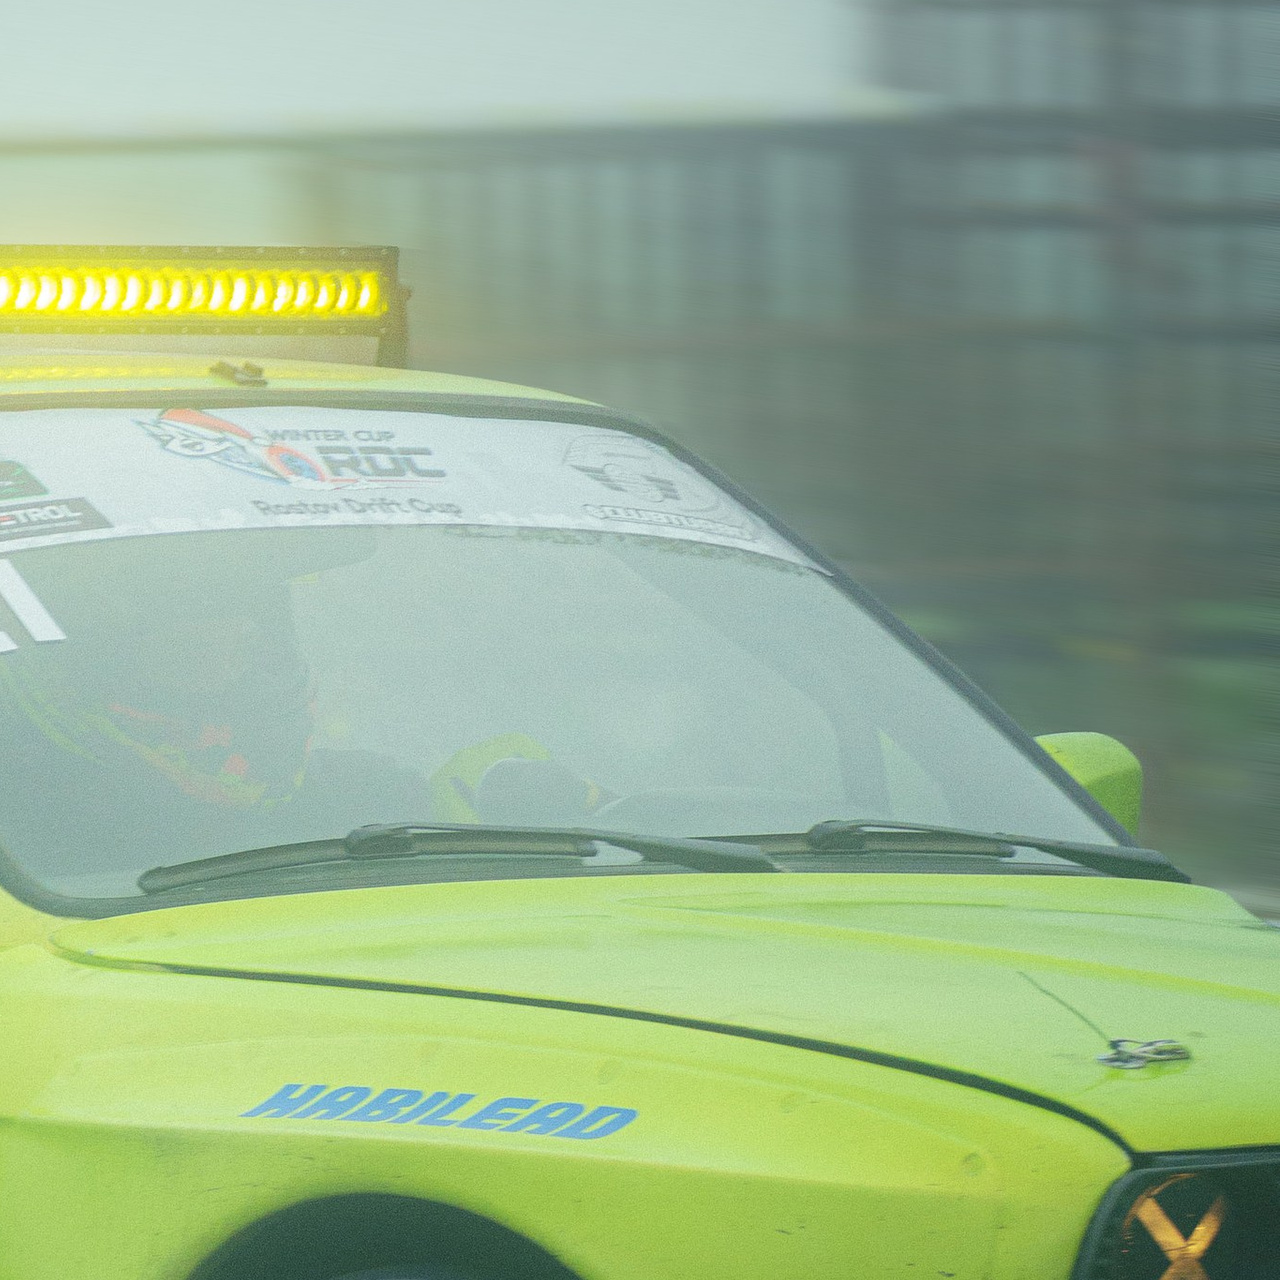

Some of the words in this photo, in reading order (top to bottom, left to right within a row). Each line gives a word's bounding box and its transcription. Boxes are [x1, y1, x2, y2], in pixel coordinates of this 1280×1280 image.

[267, 428, 350, 442] WINTER
[353, 429, 396, 442] CUP
[316, 445, 447, 478] RDC
[252, 499, 340, 516] Rostov
[342, 497, 406, 514] Drift
[407, 498, 463, 517] Cup
[239, 1083, 638, 1140] HABILEAD
